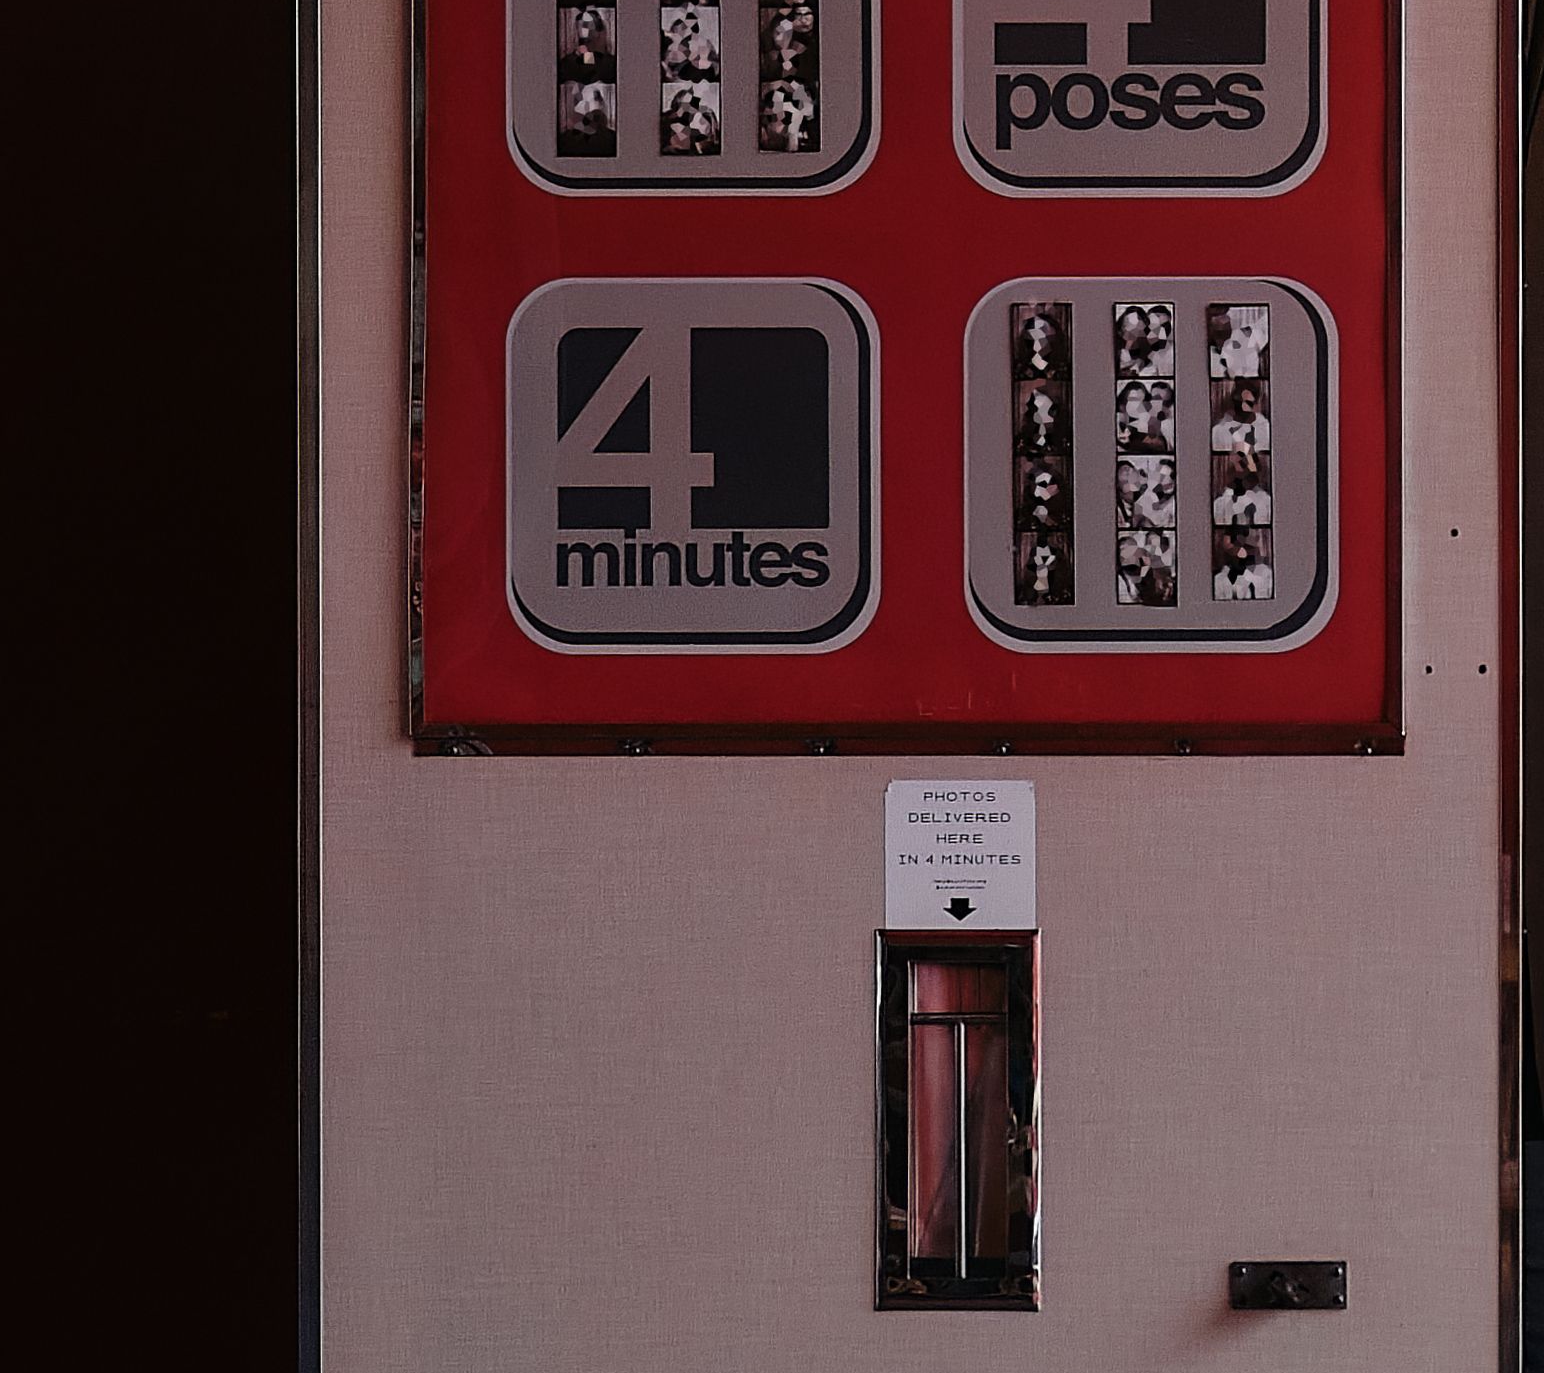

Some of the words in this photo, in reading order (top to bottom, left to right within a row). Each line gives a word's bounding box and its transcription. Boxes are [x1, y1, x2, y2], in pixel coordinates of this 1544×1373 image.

[995, 71, 1266, 151] poses
[556, 326, 715, 530] 4
[555, 525, 831, 588] minutes
[923, 791, 996, 802] PHOTOS
[908, 812, 1011, 823] DELIVERED
[936, 834, 984, 844] HERE
[898, 854, 918, 865] IN
[925, 854, 934, 865] 4
[941, 854, 1022, 865] MINUTES
